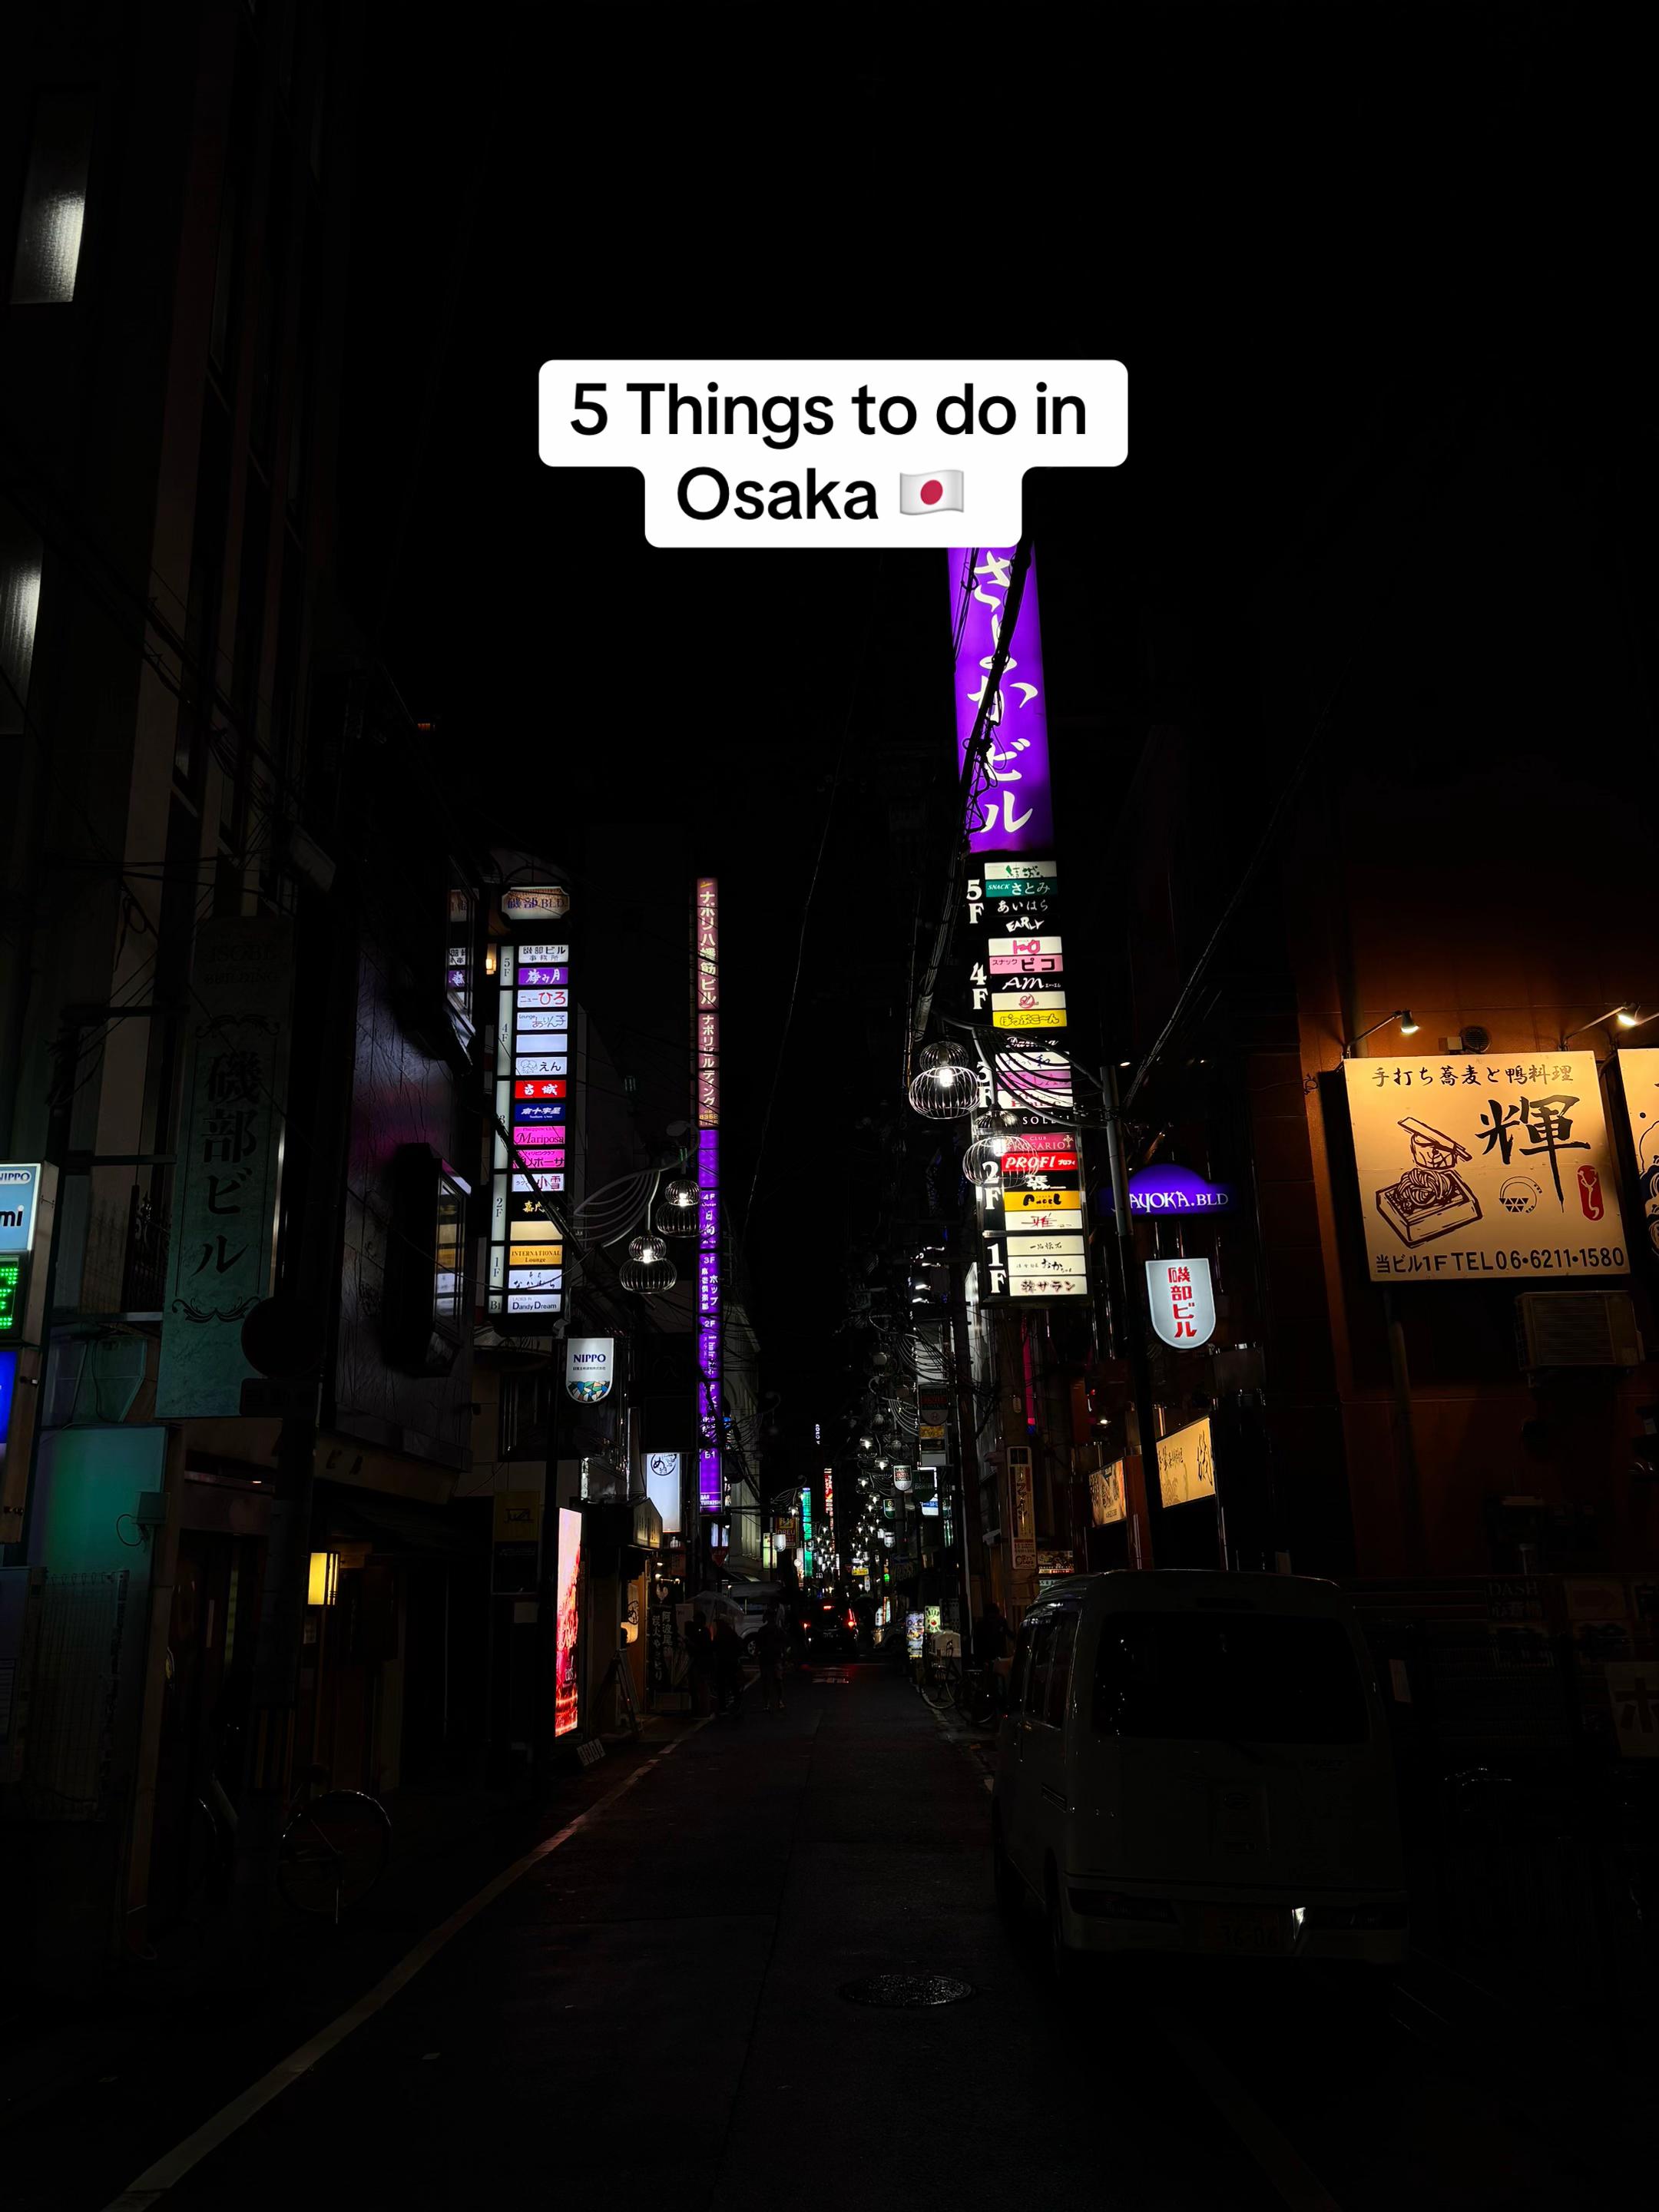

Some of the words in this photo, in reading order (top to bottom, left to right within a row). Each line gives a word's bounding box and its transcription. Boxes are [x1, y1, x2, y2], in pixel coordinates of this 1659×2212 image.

[1012, 882, 1051, 896] さとみ
[966, 879, 984, 924] 5F
[997, 899, 1048, 913] あいはら
[1005, 916, 1045, 932] EARLY
[1022, 958, 1055, 971] ピコ
[969, 962, 988, 1010] 4F
[539, 1061, 561, 1072] えん
[1372, 1064, 1575, 1088] 手打ち蕎麦と鴨料理
[514, 1132, 565, 1144] Mariposa
[191, 1050, 262, 1277] 磯部ビル
[1475, 1094, 1591, 1214] 輝
[538, 1175, 561, 1190] 小雪
[982, 1161, 1002, 1210] 2F
[987, 1243, 1007, 1293] 1F
[1167, 1267, 1197, 1338] 磯部ビル
[573, 1354, 606, 1363] NIPPO
